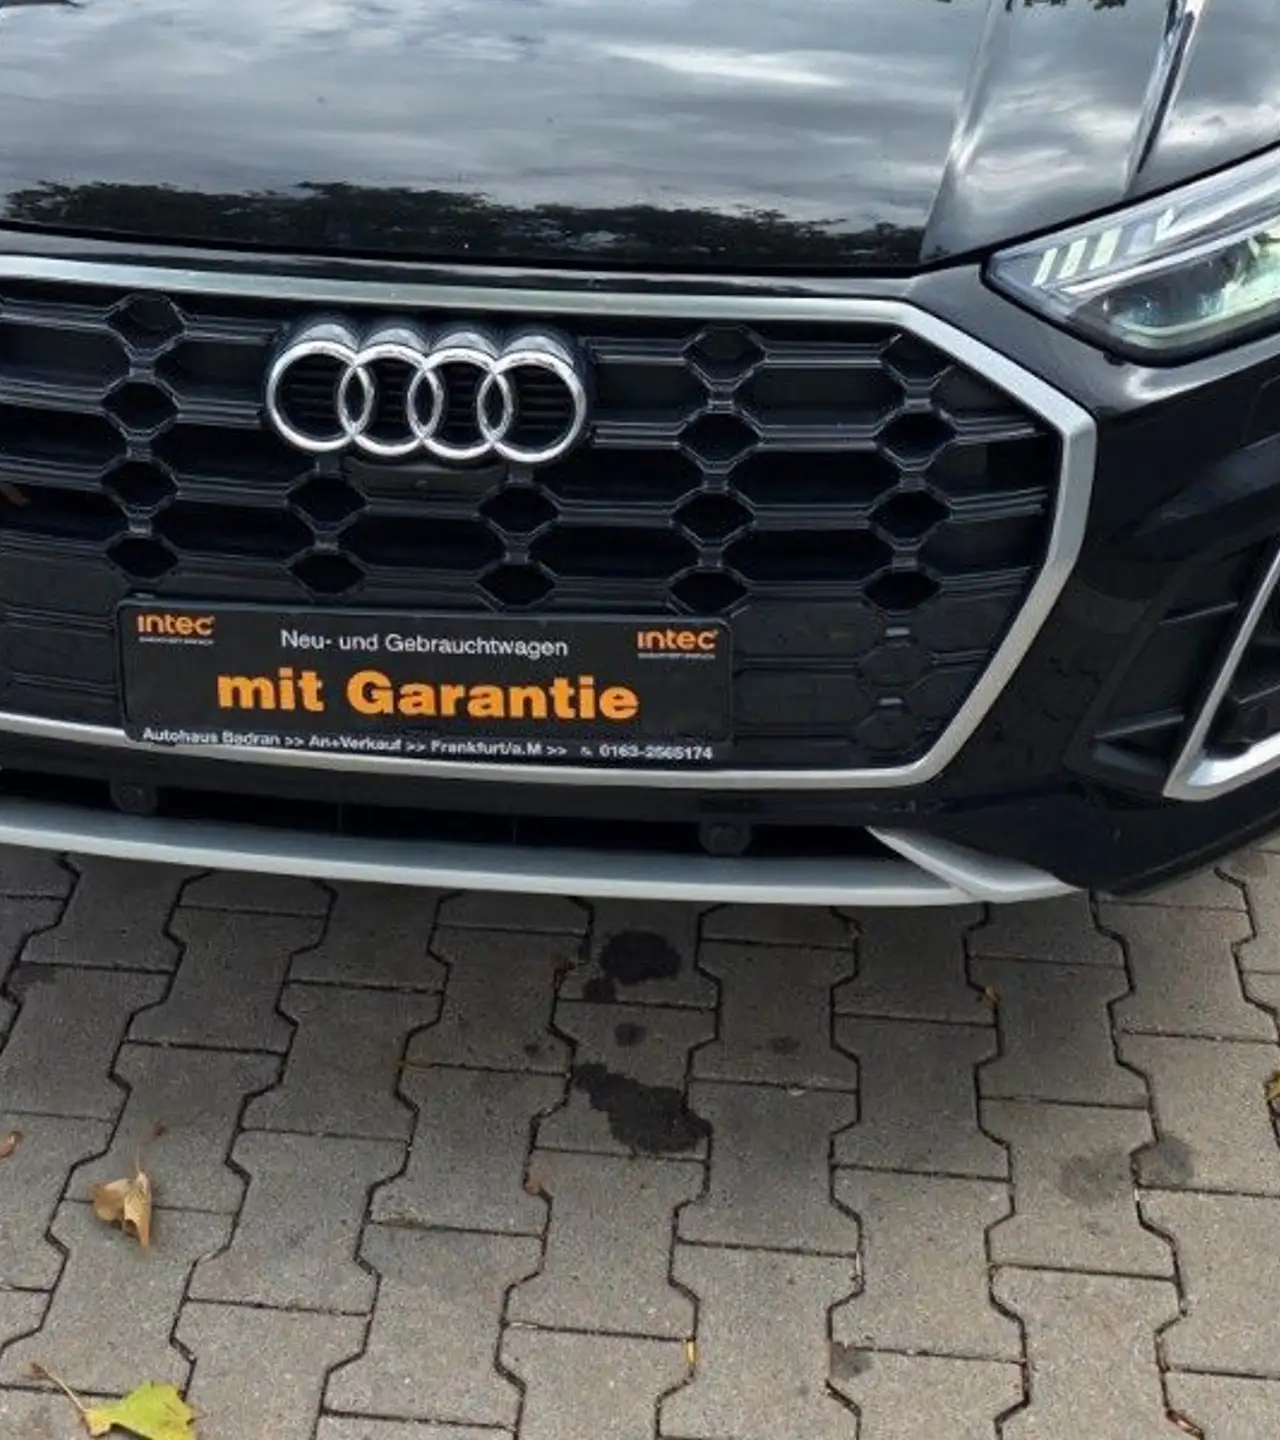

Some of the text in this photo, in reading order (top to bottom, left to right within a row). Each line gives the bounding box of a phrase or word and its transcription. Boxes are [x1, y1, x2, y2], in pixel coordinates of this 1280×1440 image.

[137, 614, 215, 636] intec
[280, 629, 569, 661] Neu- und Gebrauchtwagen
[637, 629, 718, 650] intec
[217, 666, 639, 720] mit Garantie
[142, 727, 218, 744] Autohaus
